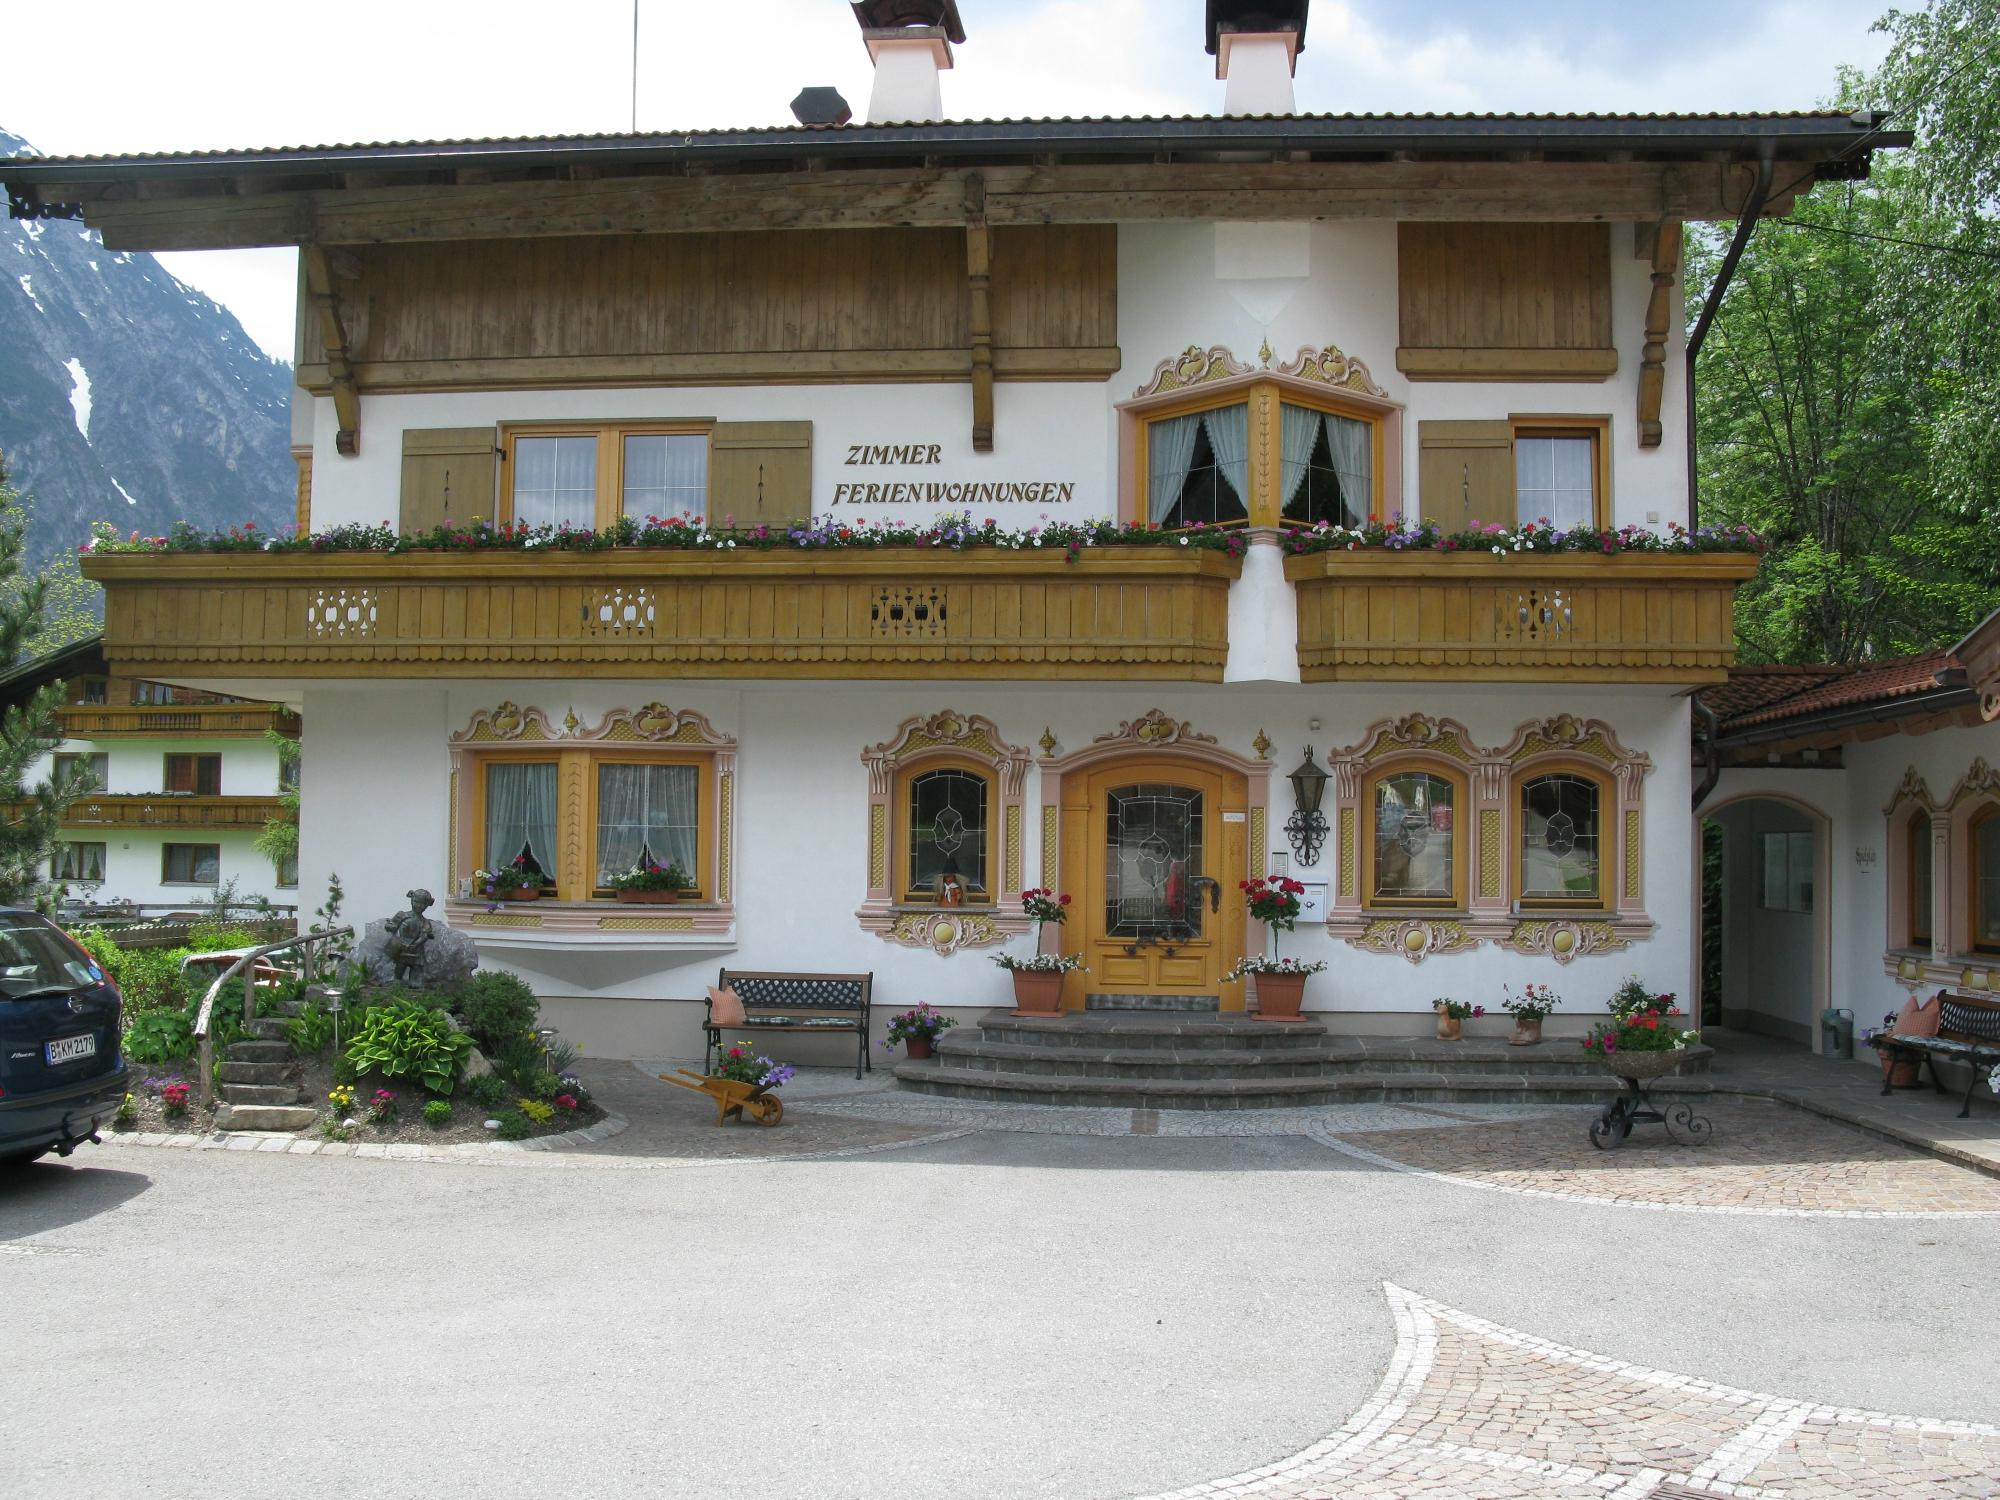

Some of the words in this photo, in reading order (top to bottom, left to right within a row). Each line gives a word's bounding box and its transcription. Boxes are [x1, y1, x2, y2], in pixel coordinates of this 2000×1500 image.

[844, 443, 942, 465] ZIMMER
[831, 481, 1076, 506] FERIENWOHNUNGEN
[50, 1043, 57, 1059] B
